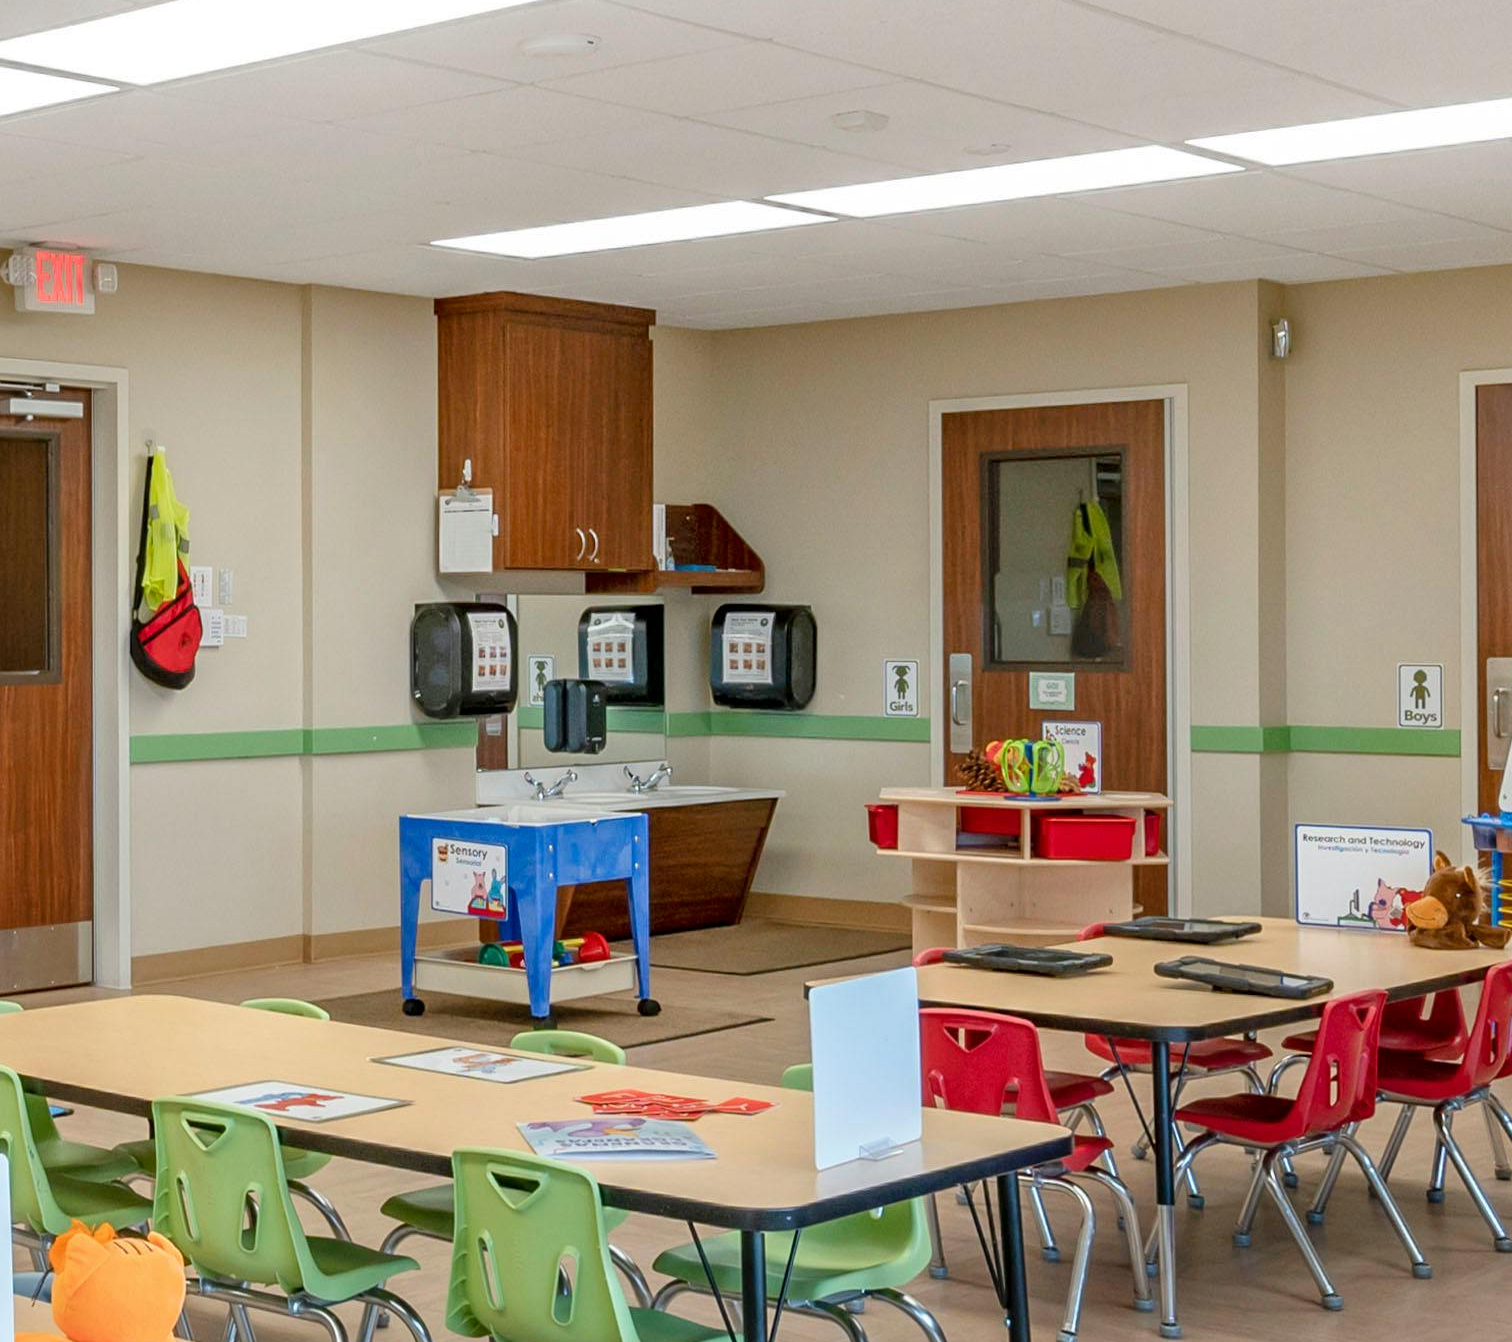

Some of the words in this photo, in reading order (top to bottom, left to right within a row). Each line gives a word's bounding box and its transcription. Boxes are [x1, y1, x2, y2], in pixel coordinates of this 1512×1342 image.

[36, 250, 85, 307] EXIT
[889, 701, 914, 712] Girls
[1404, 710, 1438, 725] Boys
[1055, 725, 1087, 736] Science
[1302, 833, 1346, 843] Research
[1347, 835, 1367, 845] and
[1370, 836, 1426, 850] Technology
[450, 843, 488, 861] Sensory
